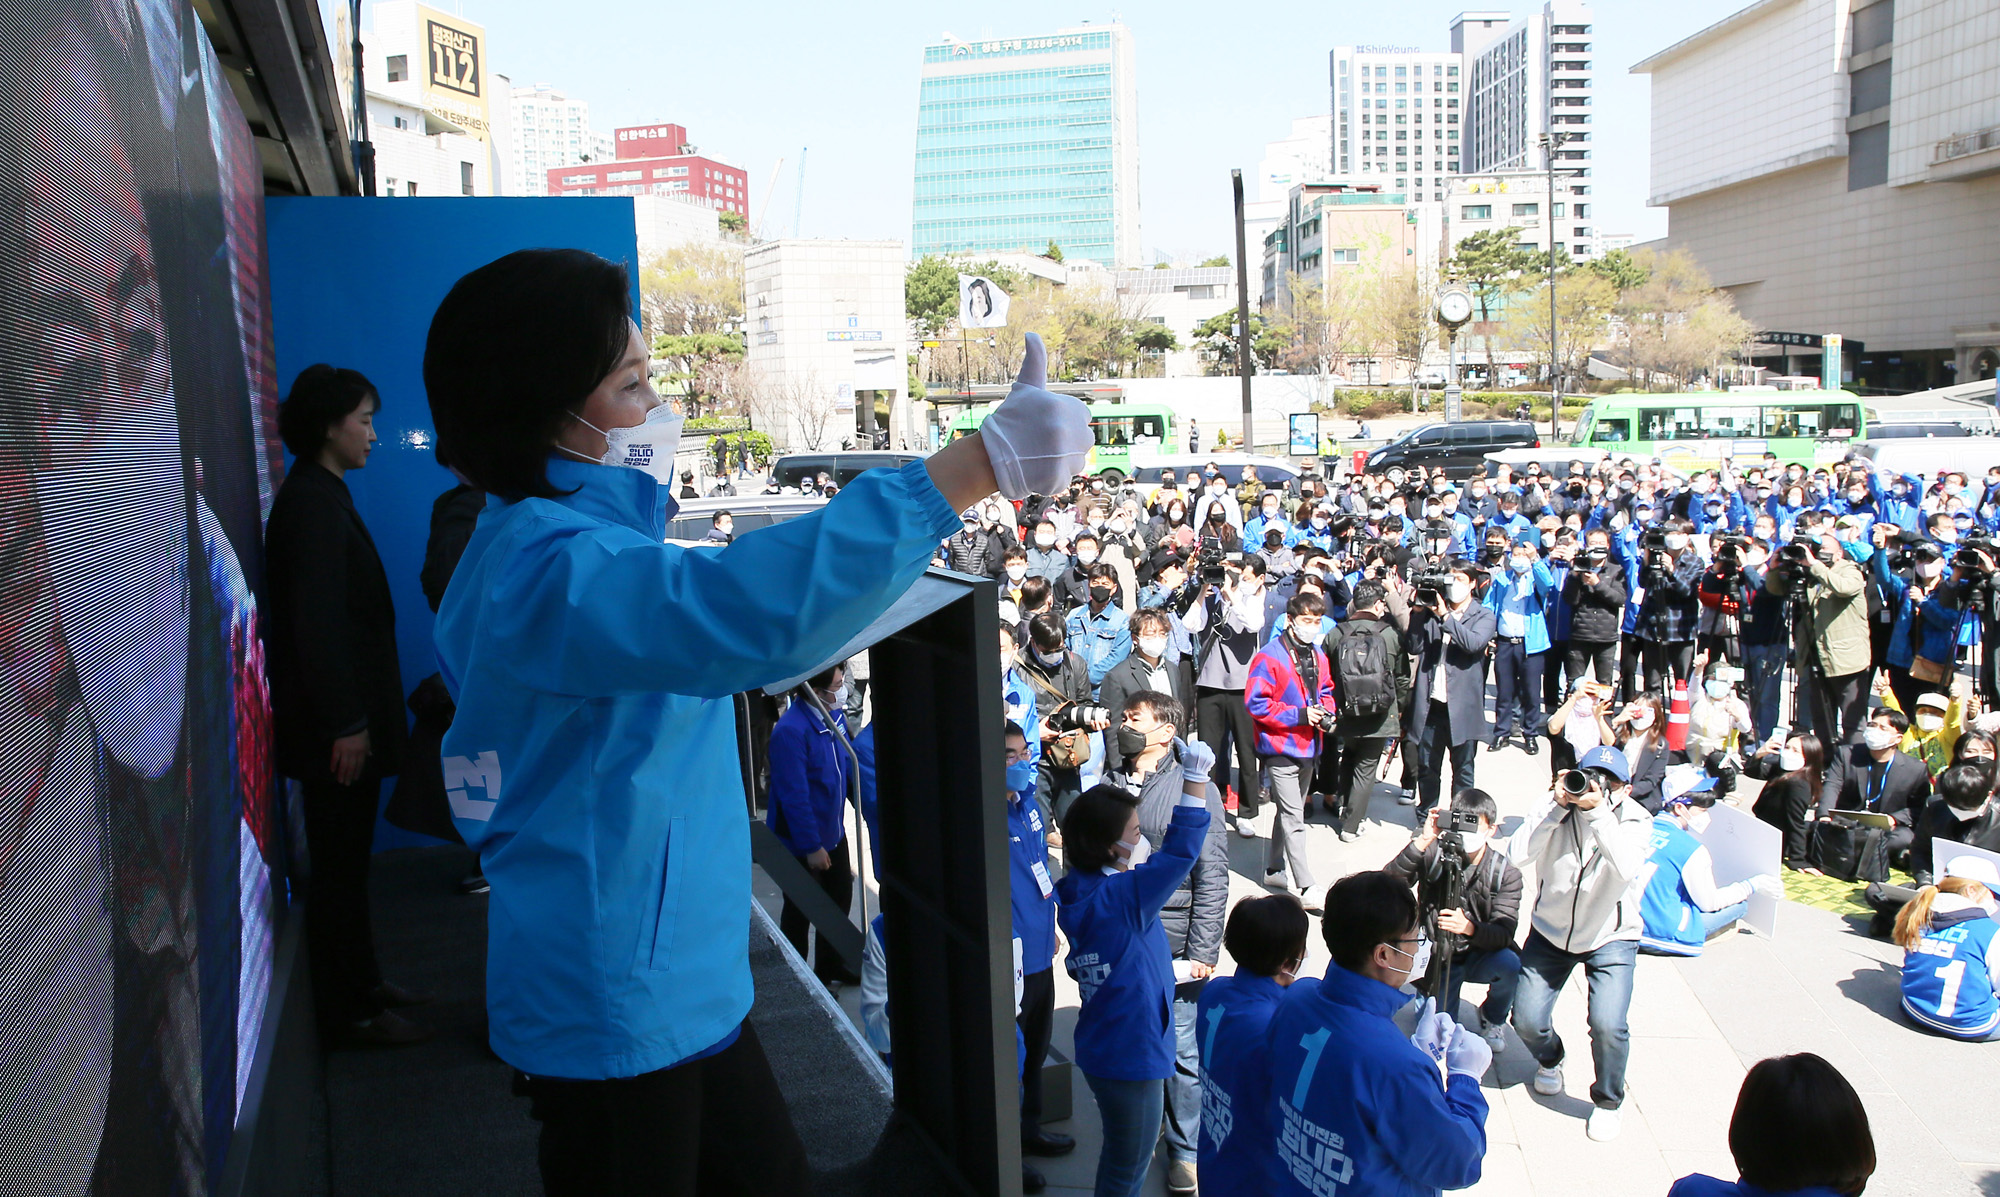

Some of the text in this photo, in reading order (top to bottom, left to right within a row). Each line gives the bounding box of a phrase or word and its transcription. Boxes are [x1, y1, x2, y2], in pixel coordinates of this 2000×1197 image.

[431, 24, 473, 55] 범죄신고
[1365, 44, 1421, 54] ShinYoung
[432, 42, 476, 93] 112
[623, 457, 651, 466] 박영선
[629, 448, 654, 457] 합니다
[1599, 747, 1614, 764] LA
[1934, 959, 1967, 1018] 1
[1203, 1003, 1227, 1071] 1
[1291, 1026, 1332, 1112] 1
[1279, 1095, 1345, 1151] 서울시 대전환
[1281, 1116, 1355, 1185] 합니다
